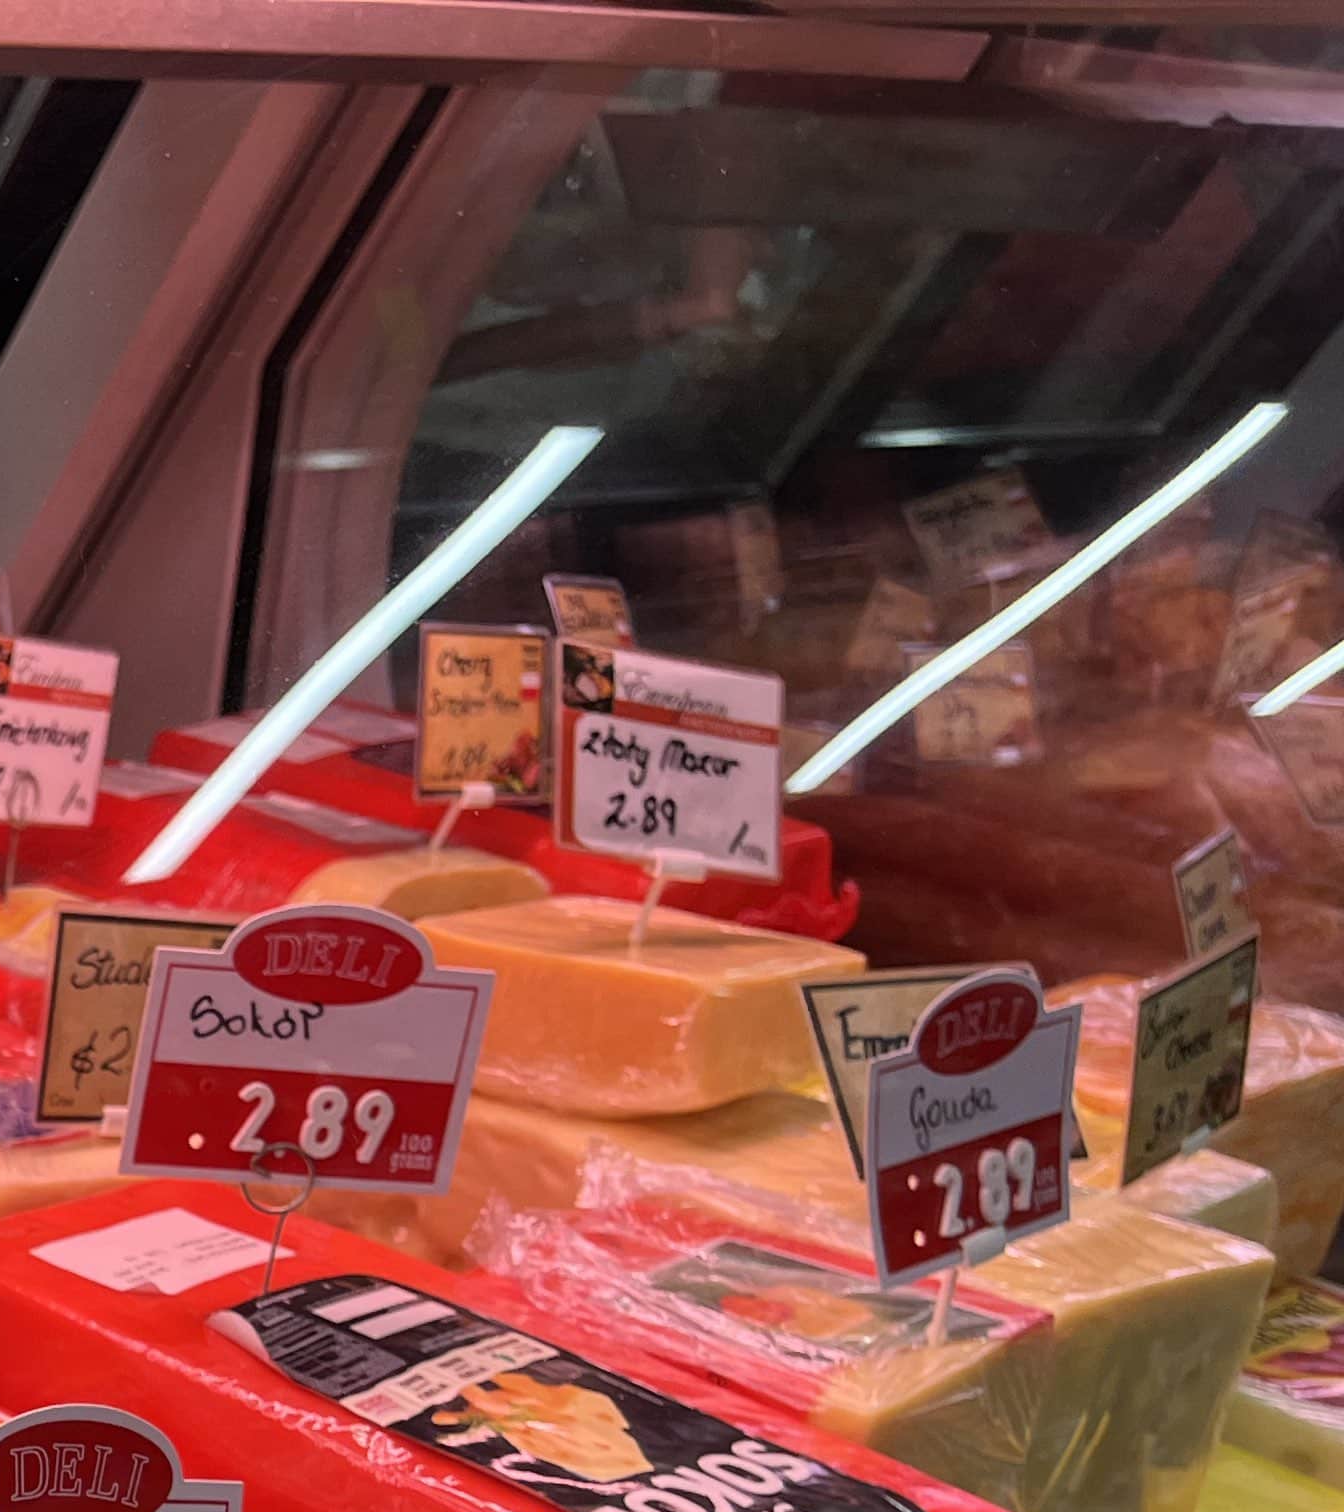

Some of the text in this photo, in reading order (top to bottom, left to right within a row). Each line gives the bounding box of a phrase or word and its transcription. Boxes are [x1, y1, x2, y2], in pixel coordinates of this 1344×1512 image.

[603, 794, 677, 838] 2.89
[262, 931, 403, 989] DELI
[936, 995, 1026, 1059] DELI
[933, 1136, 1036, 1238] 2.89
[11, 1443, 150, 1508] DELI
